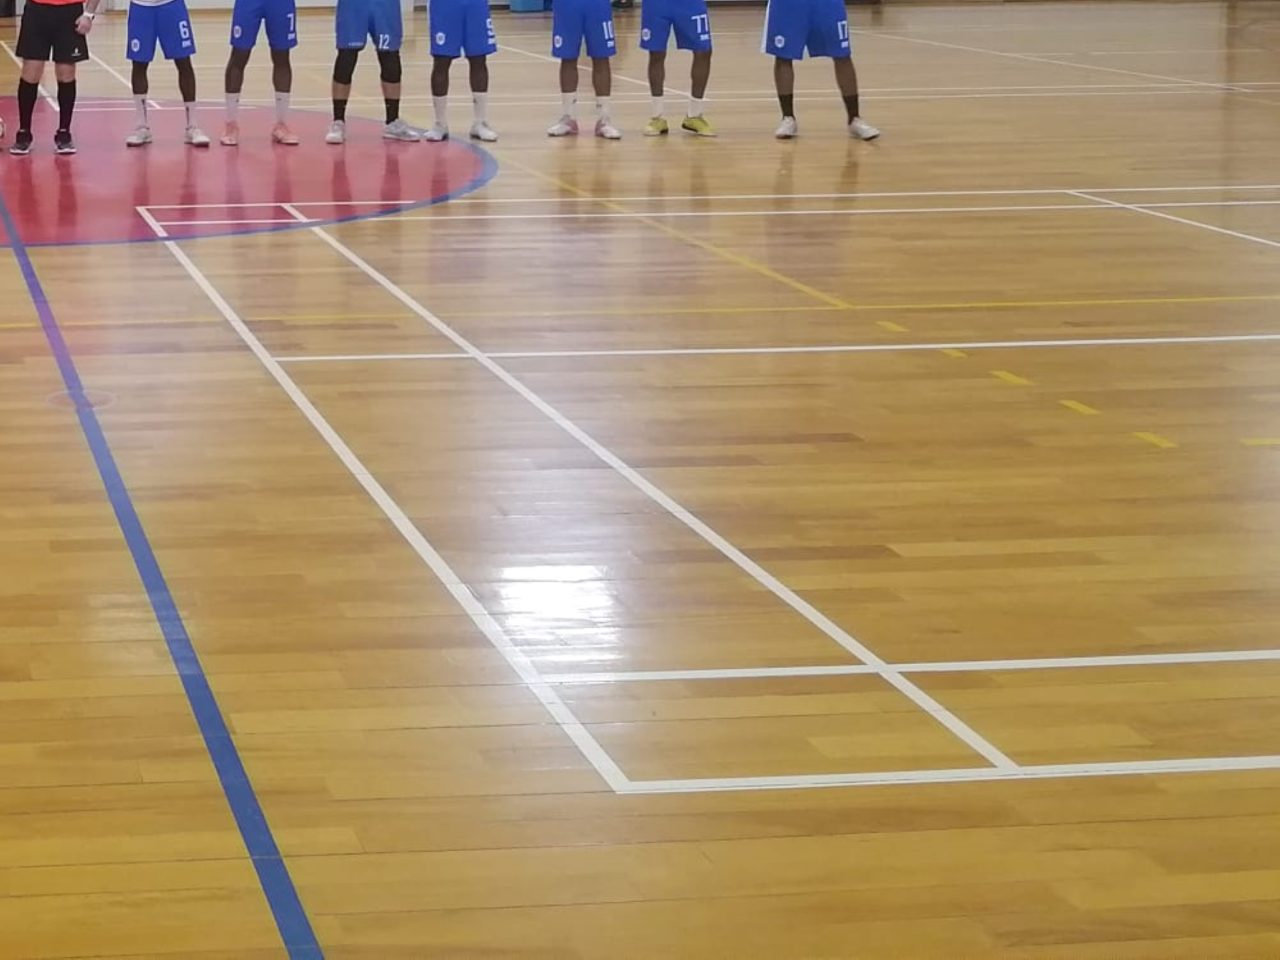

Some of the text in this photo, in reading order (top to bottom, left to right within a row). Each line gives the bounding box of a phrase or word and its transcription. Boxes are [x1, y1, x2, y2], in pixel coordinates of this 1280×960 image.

[179, 20, 190, 39] 6
[286, 13, 295, 32] 7
[691, 13, 709, 34] 77
[378, 33, 390, 50] 12
